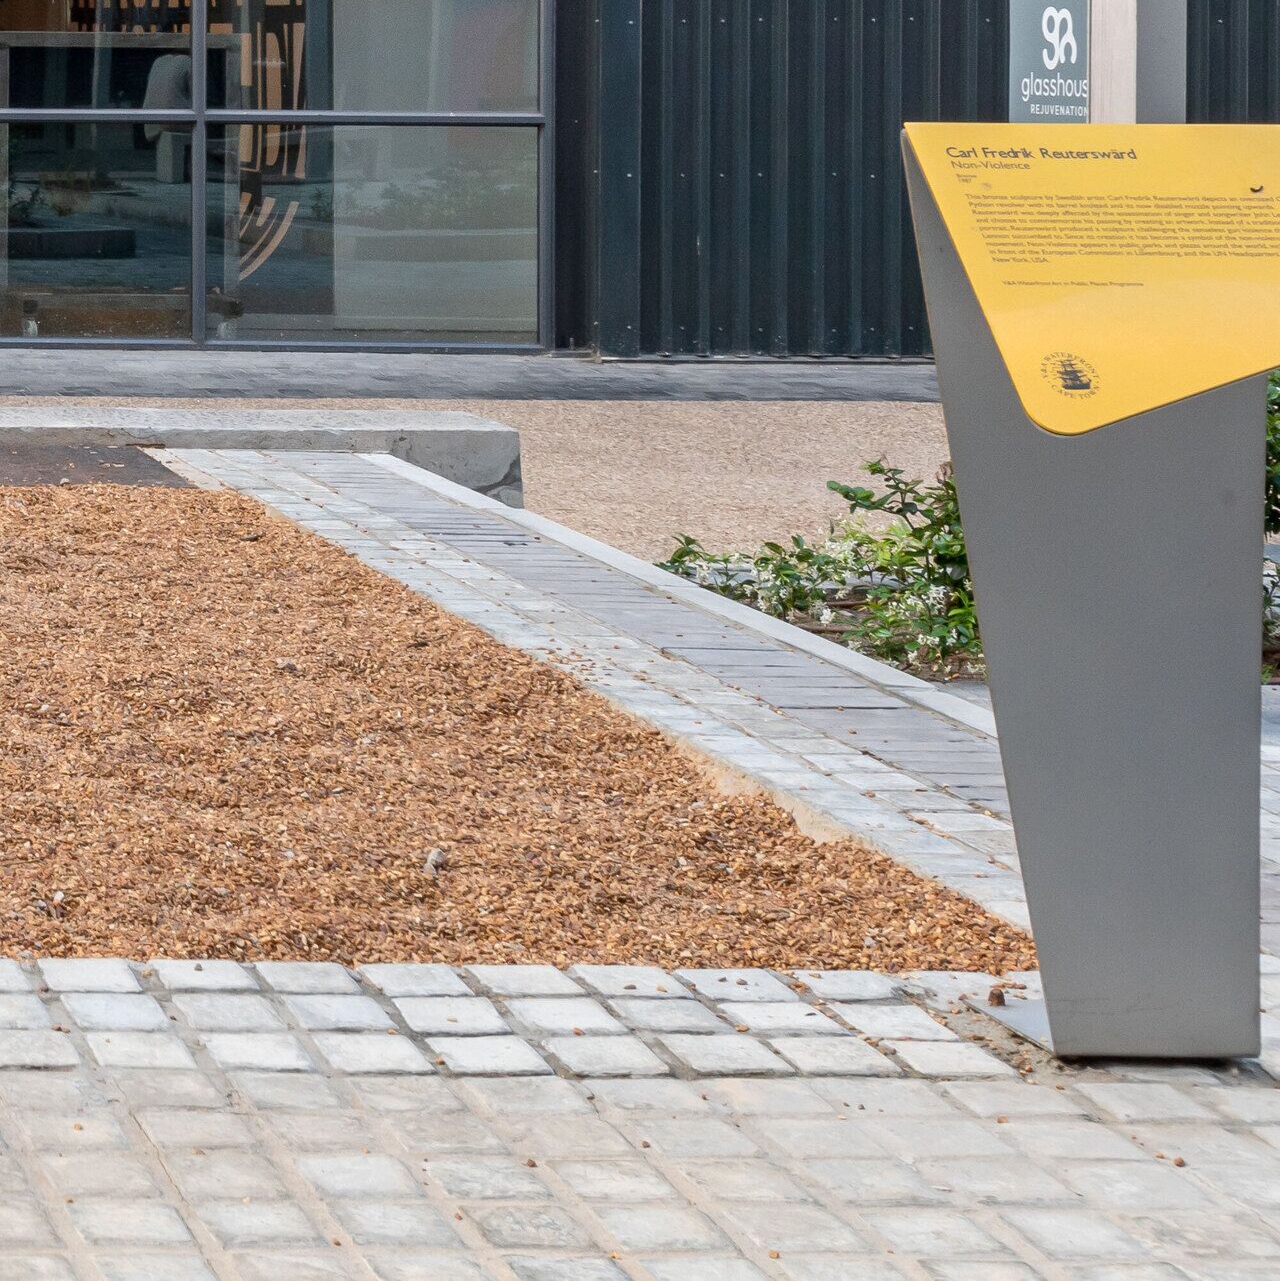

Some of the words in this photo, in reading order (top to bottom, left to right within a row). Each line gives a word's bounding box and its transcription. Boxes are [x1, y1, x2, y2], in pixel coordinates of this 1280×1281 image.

[1021, 72, 1088, 102] glasshous
[946, 147, 977, 158] Carl
[982, 148, 1035, 158] Fredrik
[1040, 148, 1137, 159] Reuterswärd
[951, 161, 1031, 170] Non-Violence
